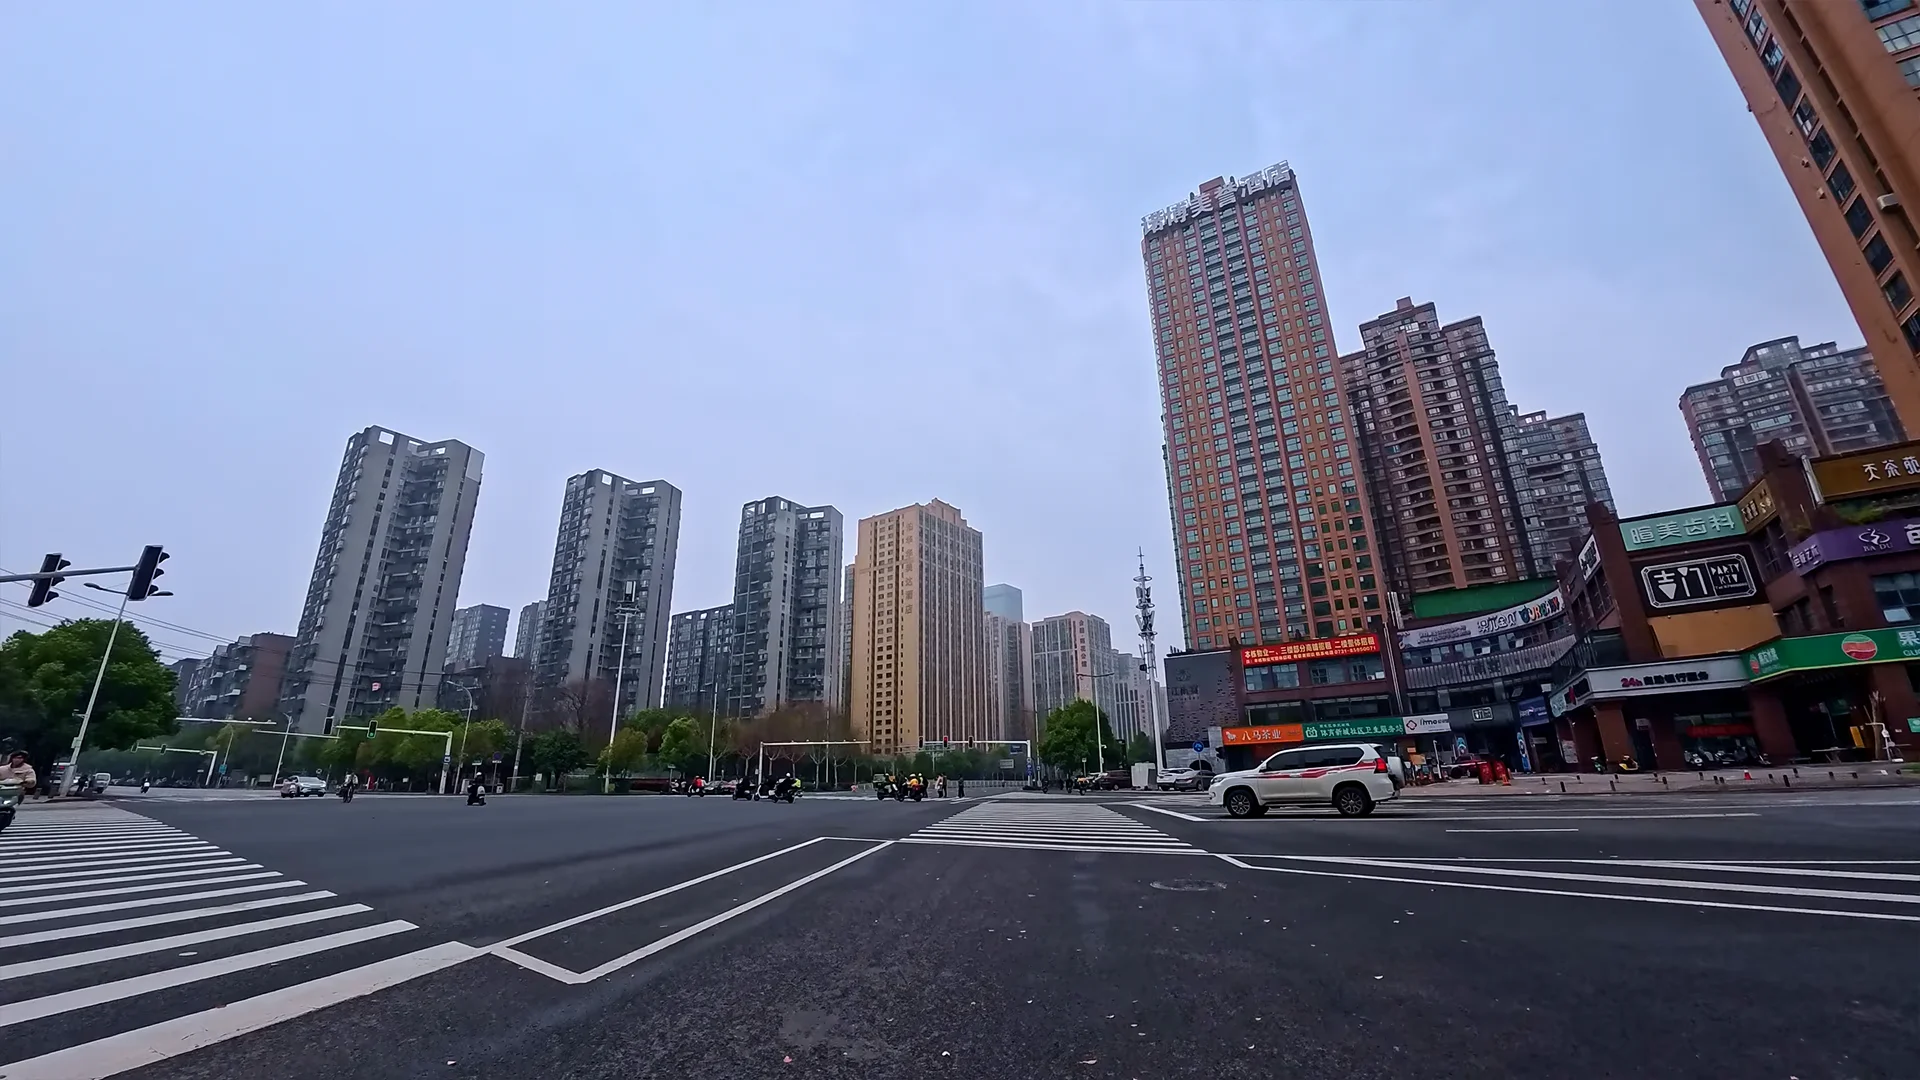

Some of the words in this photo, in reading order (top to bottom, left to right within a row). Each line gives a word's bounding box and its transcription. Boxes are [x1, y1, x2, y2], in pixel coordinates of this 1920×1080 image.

[1710, 563, 1740, 576] PARTY
[1719, 573, 1738, 584] KTV
[1242, 729, 1281, 741] 八马茶业
